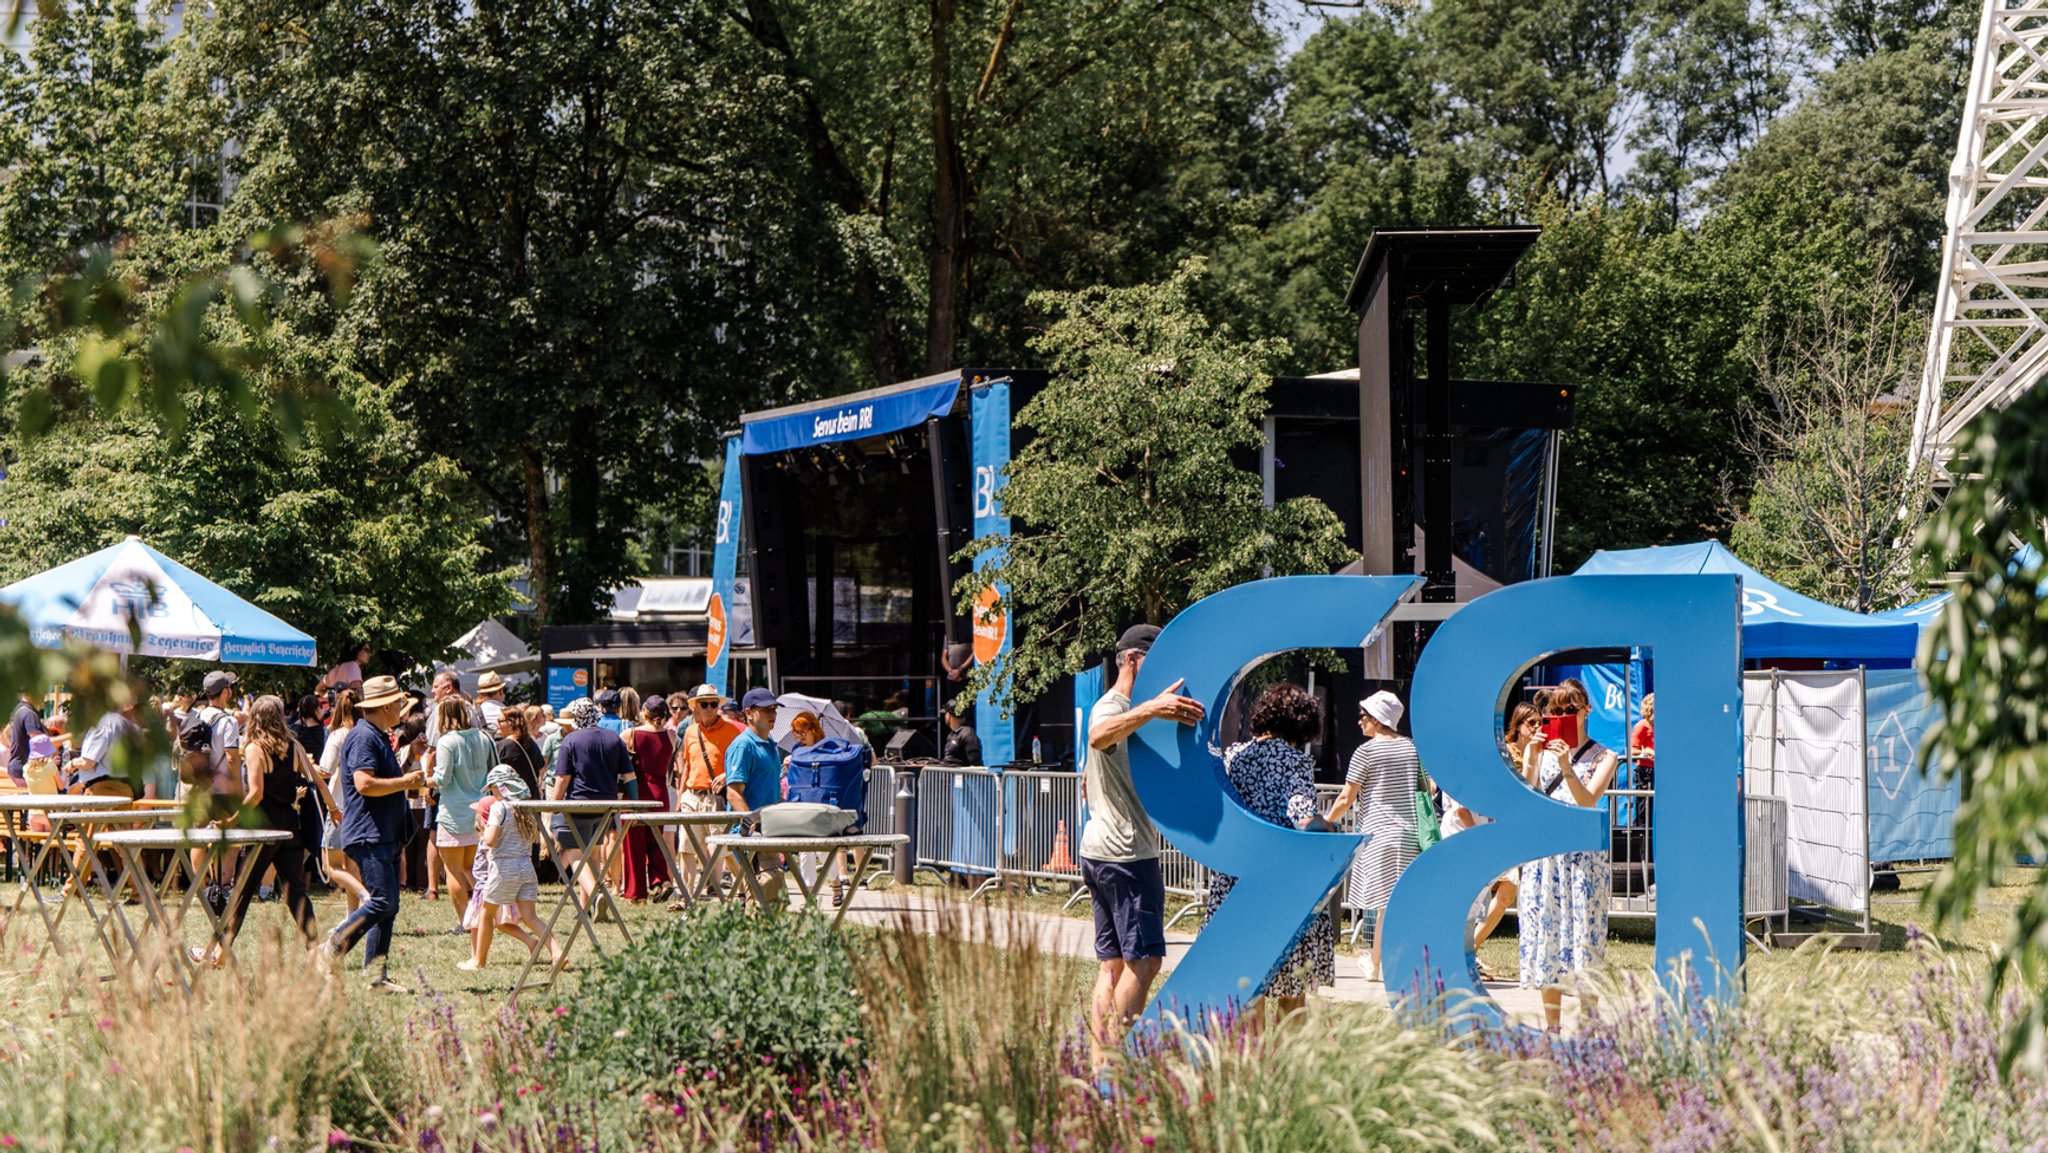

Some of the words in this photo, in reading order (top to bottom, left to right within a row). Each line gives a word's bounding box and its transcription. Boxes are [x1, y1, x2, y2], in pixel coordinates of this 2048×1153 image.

[813, 416, 837, 438] Servus
[837, 409, 858, 434] beim
[858, 405, 873, 430] BR!
